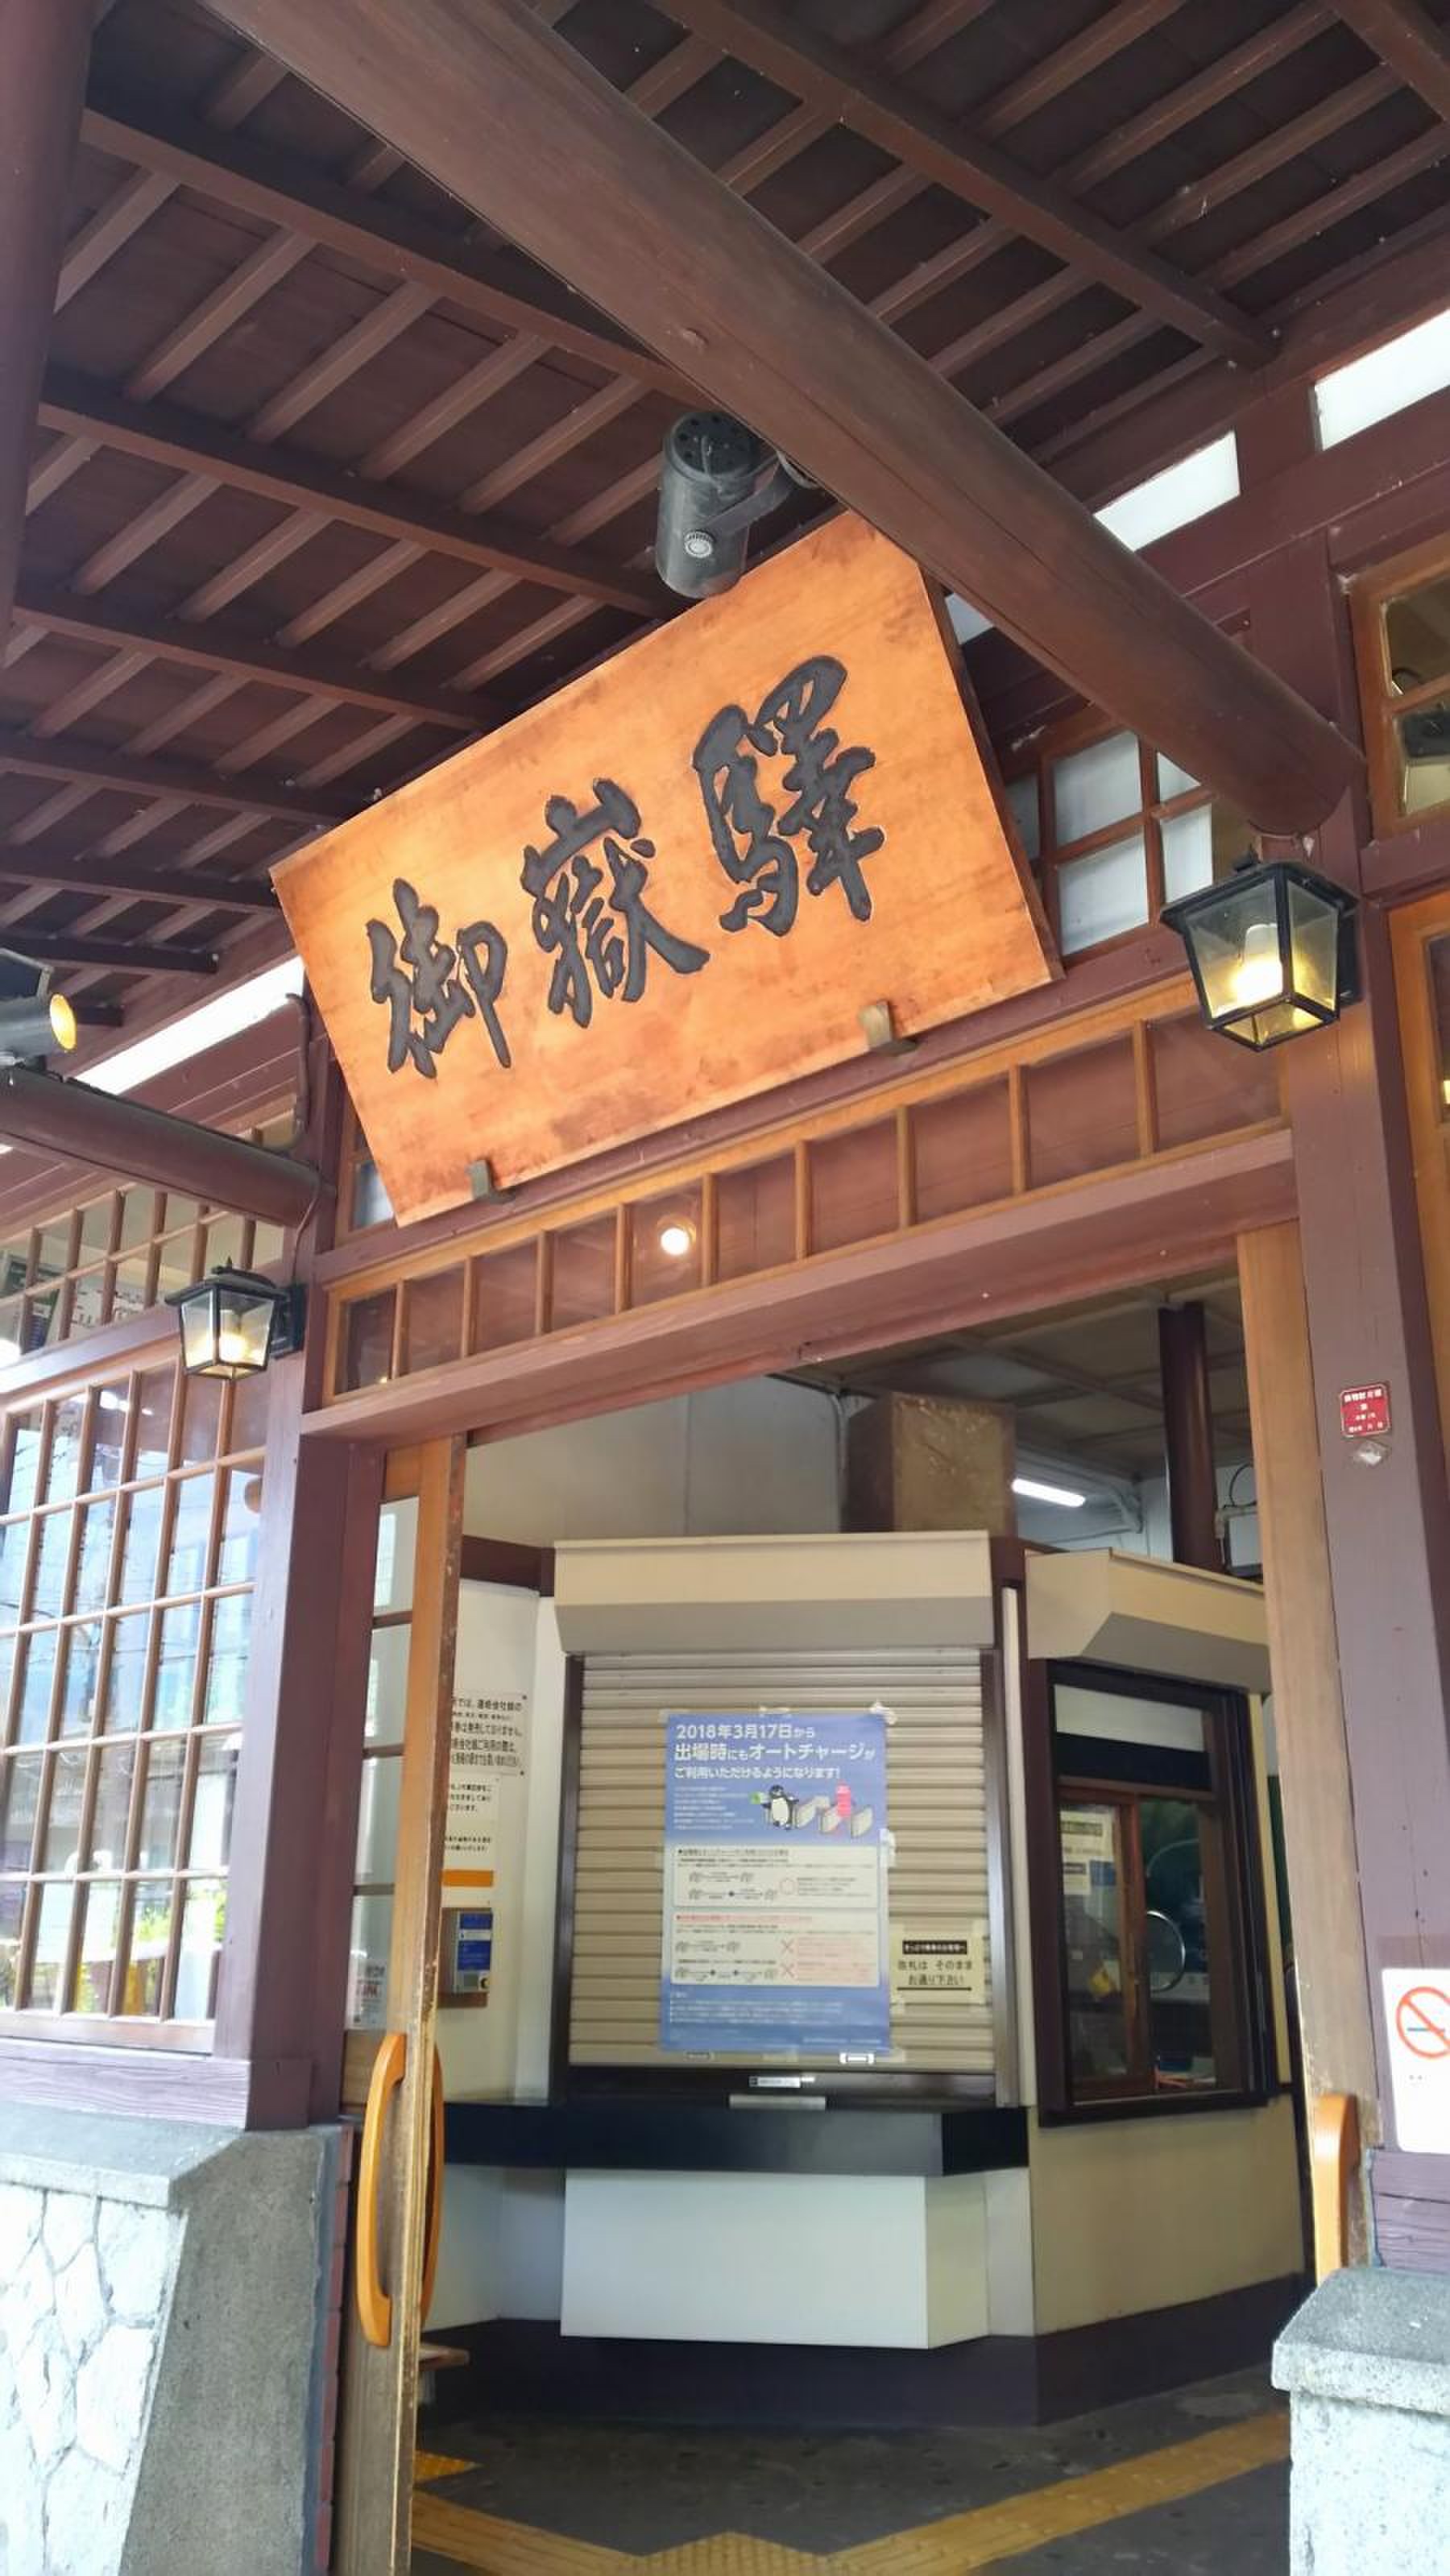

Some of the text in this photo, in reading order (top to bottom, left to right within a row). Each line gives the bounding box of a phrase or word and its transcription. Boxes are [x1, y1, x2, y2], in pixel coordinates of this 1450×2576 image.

[676, 1723, 816, 1740] 2018年3月17日から
[673, 1741, 876, 1762] 出場時にもオートチャージが
